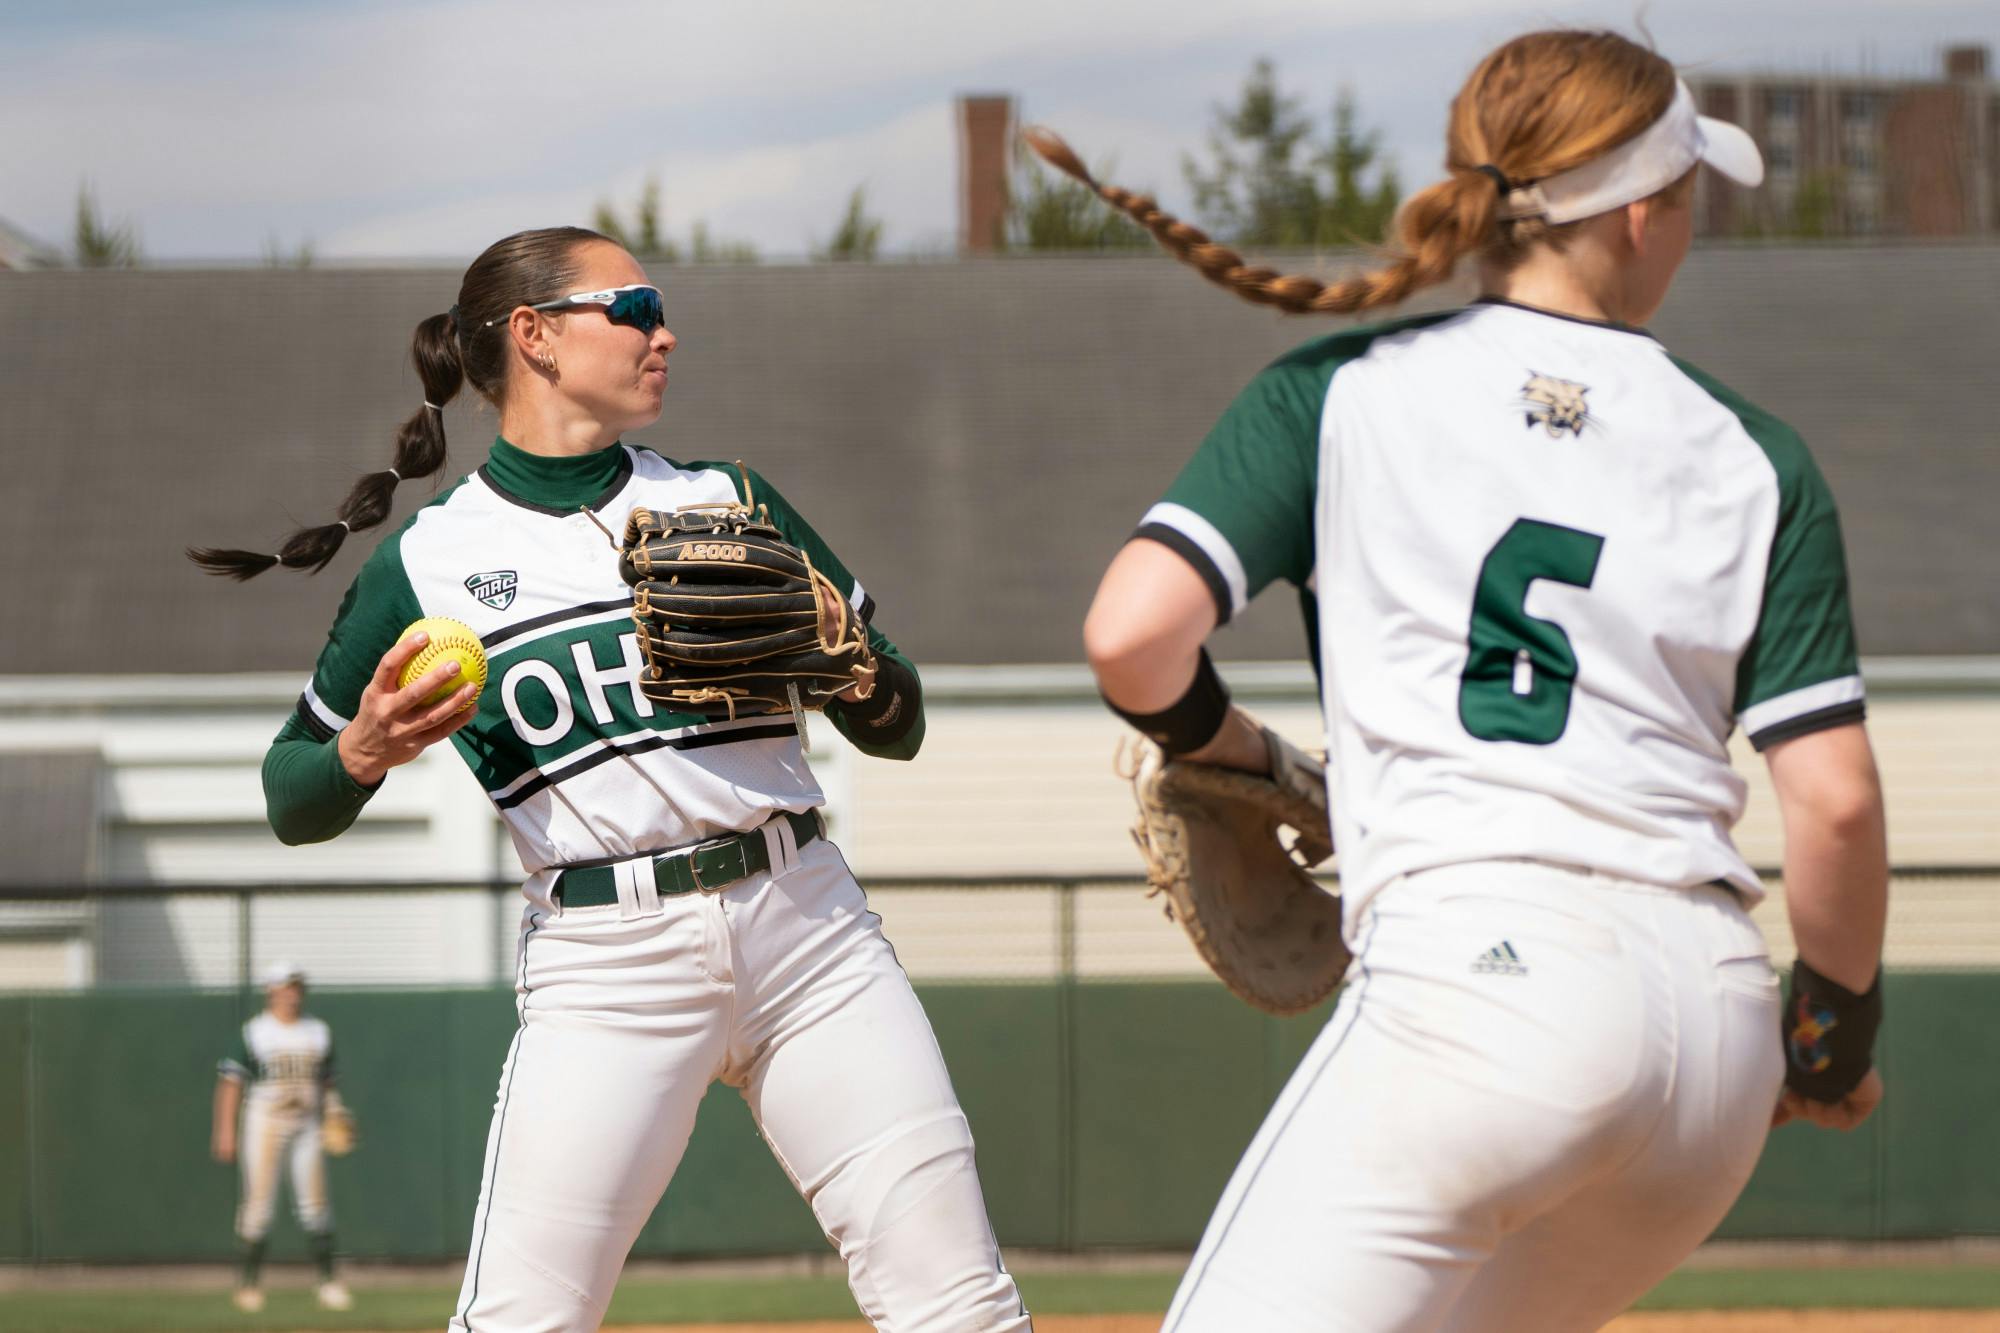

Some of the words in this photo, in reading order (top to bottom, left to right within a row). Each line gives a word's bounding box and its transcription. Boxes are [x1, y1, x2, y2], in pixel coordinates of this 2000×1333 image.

[677, 543, 747, 561] A2000
[474, 578, 518, 600] MAC
[1458, 516, 1606, 745] 6
[501, 632, 660, 747] OH
